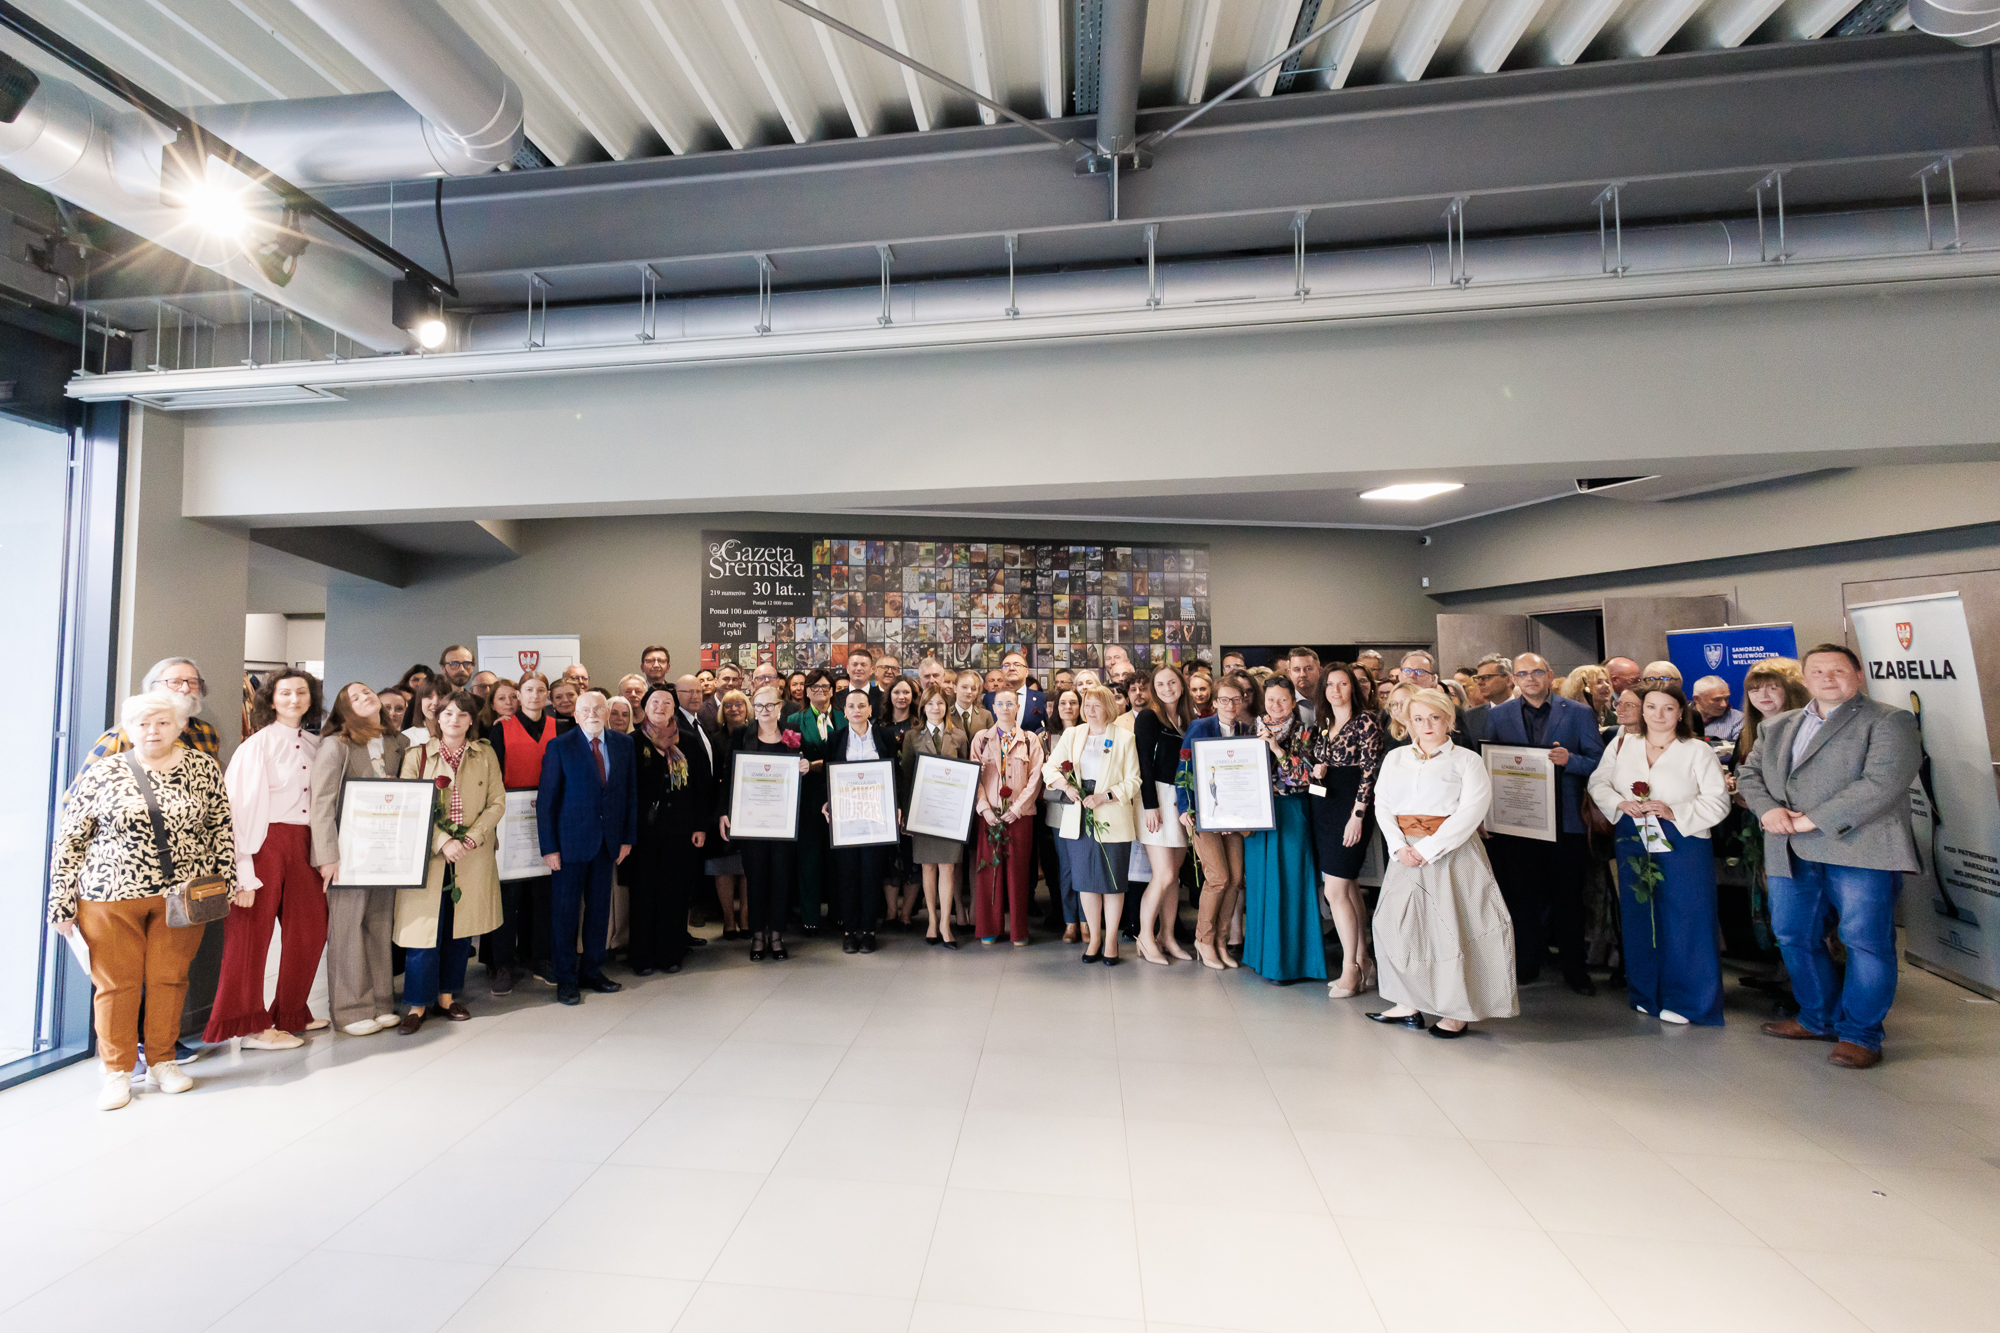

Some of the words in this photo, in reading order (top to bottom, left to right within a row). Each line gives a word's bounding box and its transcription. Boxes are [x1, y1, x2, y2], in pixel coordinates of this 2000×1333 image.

[709, 539, 795, 562] Gazeta
[752, 582, 771, 596] 30
[775, 581, 806, 596] lat...
[726, 629, 742, 637] cykli
[727, 621, 747, 629] rubryk
[1868, 659, 1957, 680] IZABELLA
[1943, 845, 1957, 854] POD
[1957, 848, 1998, 863] PATRONATEM
